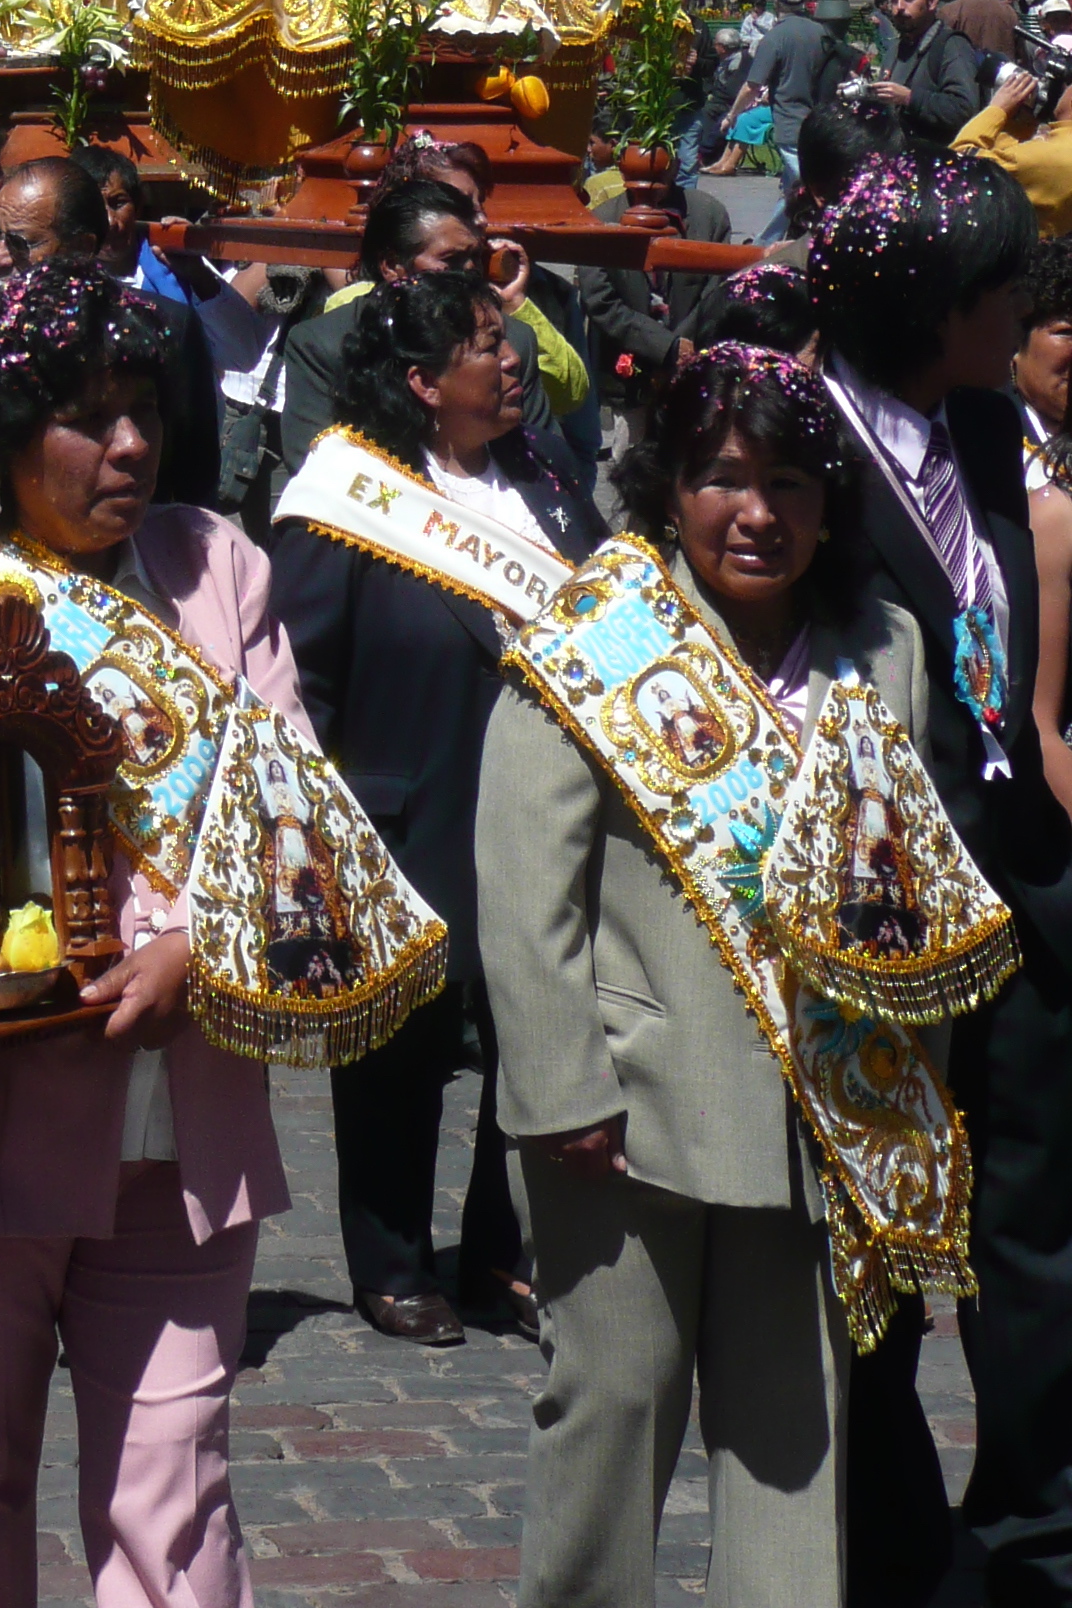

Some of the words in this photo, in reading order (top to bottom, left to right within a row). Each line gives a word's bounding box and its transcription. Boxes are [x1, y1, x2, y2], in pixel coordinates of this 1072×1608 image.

[345, 472, 403, 516] EX
[422, 509, 550, 607] MAYOR
[573, 594, 655, 663] VIRGEN
[595, 620, 676, 692] ASUNTA
[691, 758, 764, 826] 2008
